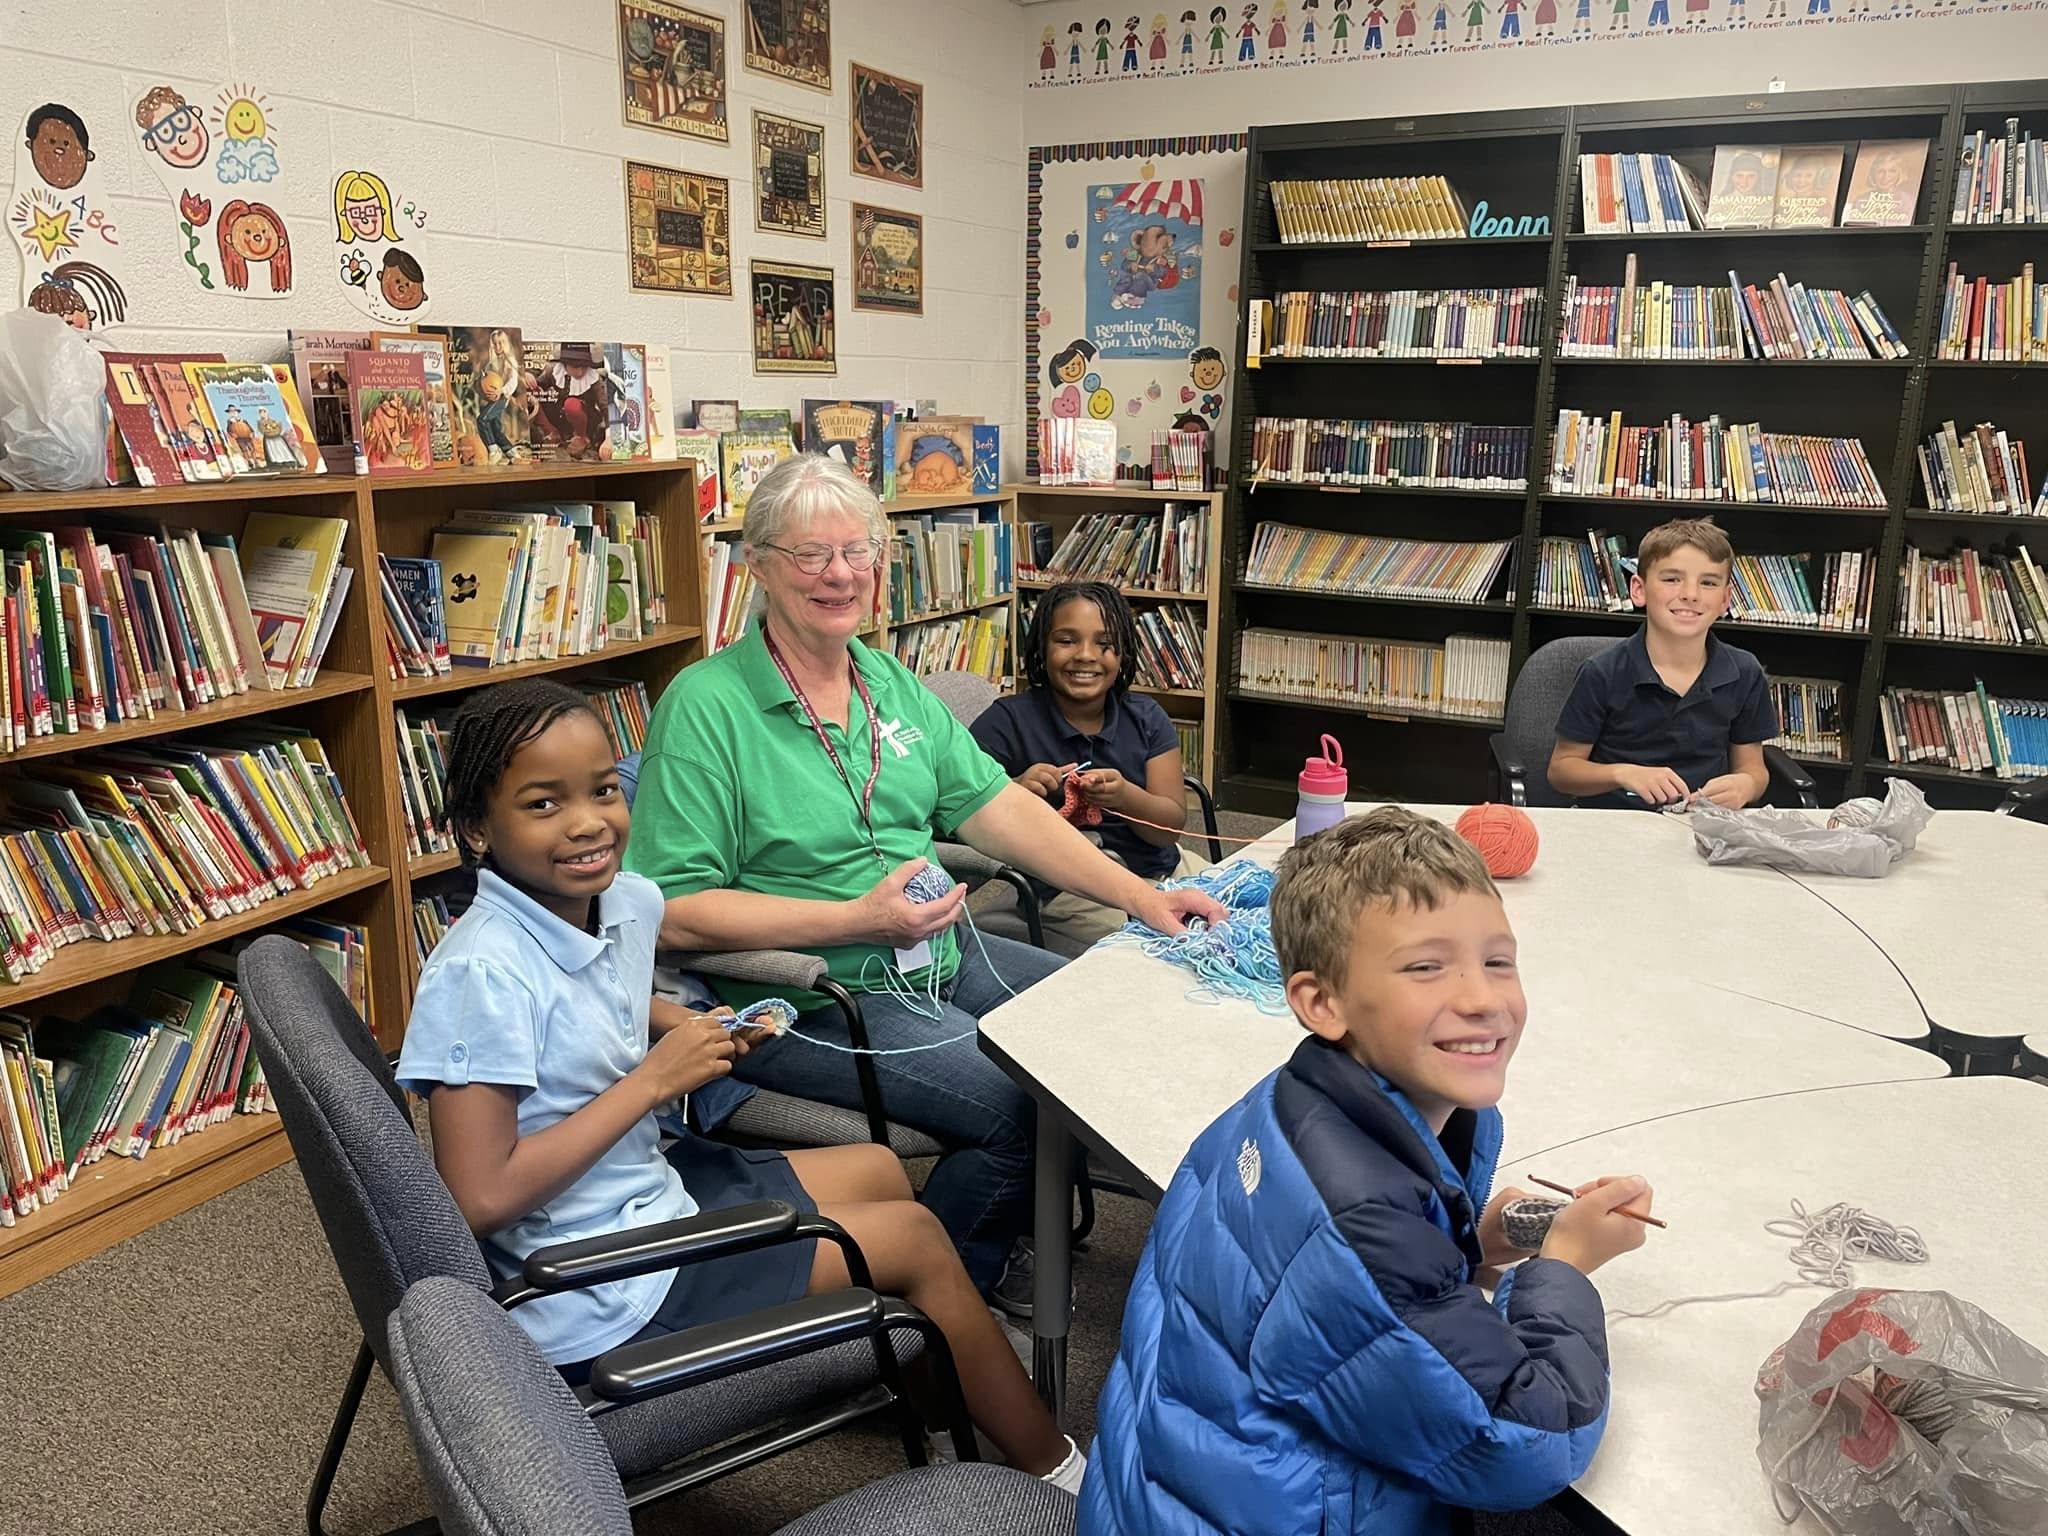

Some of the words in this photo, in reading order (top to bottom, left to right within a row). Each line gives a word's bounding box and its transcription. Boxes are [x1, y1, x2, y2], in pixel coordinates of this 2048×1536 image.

[1196, 66, 1222, 75] Forever
[1276, 60, 1300, 68] Friends
[1317, 56, 1345, 64] Forever
[1387, 50, 1402, 58] Best
[1404, 48, 1431, 56] Friends
[1448, 44, 1480, 54] Forever
[1481, 42, 1496, 50] and
[1524, 38, 1542, 47] Best
[1543, 36, 1573, 46] Friends
[1592, 32, 1626, 41] Forever
[1628, 30, 1644, 38] and
[1645, 28, 1664, 36] ever
[1674, 26, 1693, 34] Best
[1694, 24, 1726, 33] Friends
[1748, 19, 1782, 29] Forever
[1786, 18, 1802, 27] and
[1804, 17, 1826, 25] ever
[1836, 14, 1856, 23] Best
[1858, 12, 1892, 22] Friends
[1914, 8, 1954, 18] Forever
[1956, 6, 1974, 16] and
[1976, 6, 1999, 14] ever
[2010, 2, 2032, 12] Best
[1868, 191, 1894, 200] KIT'S
[1784, 204, 1819, 216] Story
[1860, 200, 1898, 211] Story
[1470, 200, 1552, 238] learn
[1775, 212, 1828, 224] Collection
[1850, 208, 1906, 222] Collection
[758, 283, 829, 321] READ
[1095, 319, 1154, 338] Reading
[1156, 316, 1197, 338] Takes
[305, 337, 324, 348] arah
[325, 337, 361, 350] Morton's
[1094, 338, 1120, 350] You
[1124, 334, 1194, 350] Anywhere
[524, 352, 554, 360] aton's
[368, 357, 410, 368] SQUANTO
[524, 360, 546, 372] Day
[360, 375, 421, 384] THANKSGIVING
[624, 370, 638, 380] NG
[120, 371, 138, 395] T
[216, 386, 265, 395] Thanksgiving
[236, 394, 271, 402] Thursday
[822, 416, 868, 428] INCREDIBLE
[833, 426, 856, 436] HOTEL
